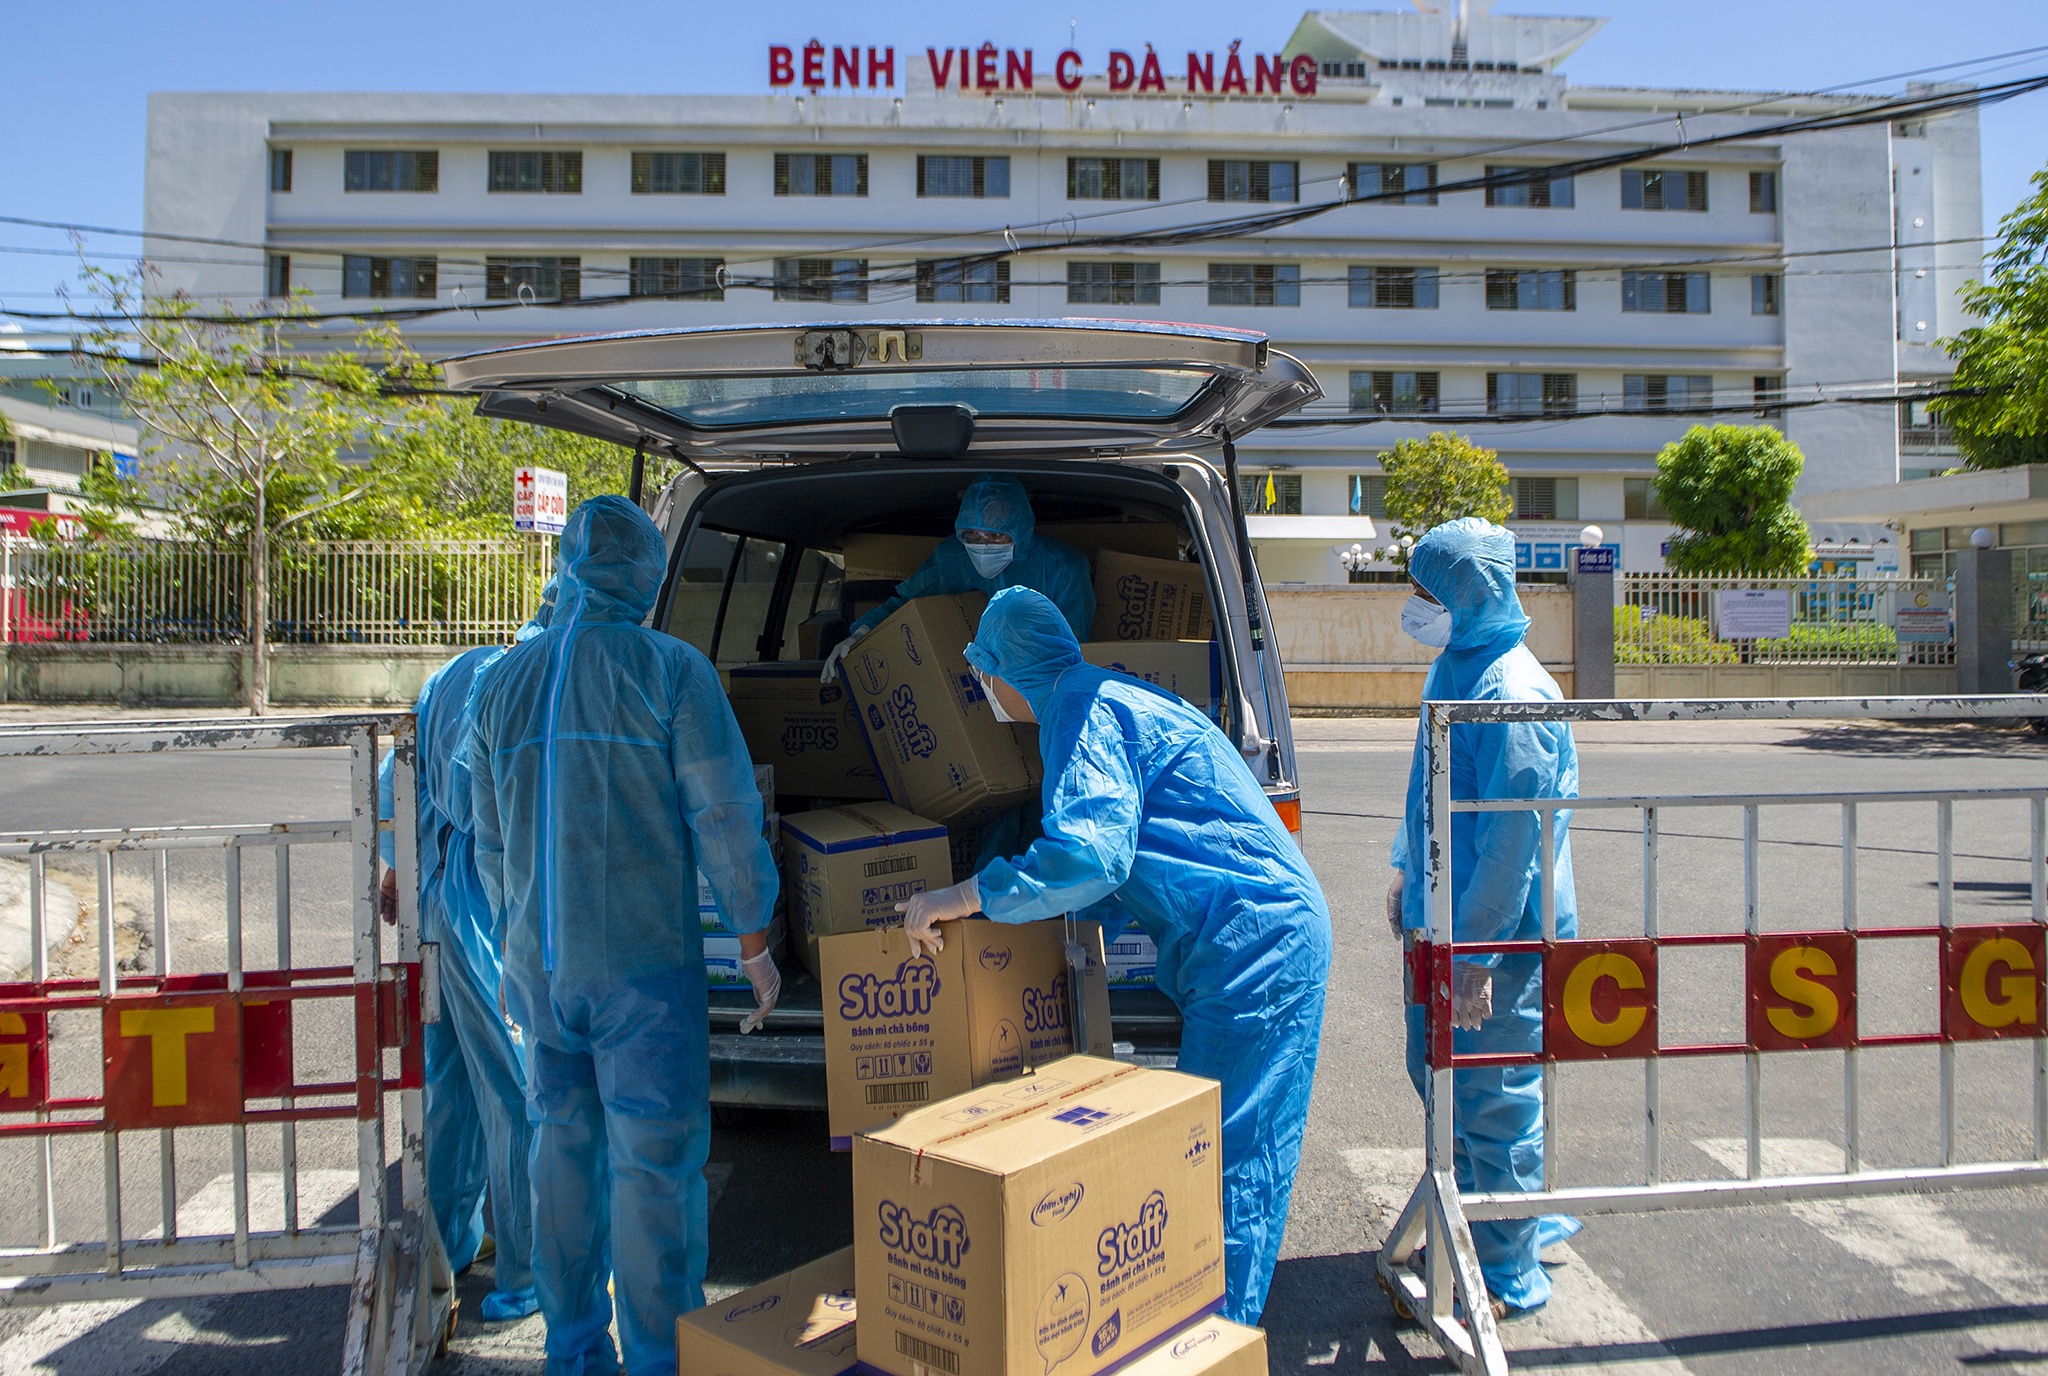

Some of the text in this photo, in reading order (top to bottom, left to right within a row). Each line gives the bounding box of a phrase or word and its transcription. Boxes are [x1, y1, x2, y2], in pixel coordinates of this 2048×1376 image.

[769, 38, 894, 96] BỆNH
[927, 40, 1033, 96] VIỆN
[1055, 50, 1084, 93] C
[1107, 42, 1167, 94] ĐÀ
[1580, 551, 1612, 564] CỔNG SỐ 1
[1117, 577, 1149, 640] Staff
[785, 725, 838, 751] Staff
[892, 684, 935, 756] Staff
[838, 964, 935, 1022] Staff
[1563, 938, 2038, 1047] C S G
[119, 1006, 215, 1108] T
[849, 1043, 863, 1052] Quy
[864, 1042, 883, 1051] cách:
[883, 1041, 892, 1049] 60
[892, 1039, 911, 1049] chiếc
[918, 1039, 928, 1047] 55
[929, 1039, 935, 1048] g
[851, 1022, 930, 1037] Bánh mì chà bông
[878, 1199, 965, 1270] Staff
[1097, 1197, 1166, 1278] Staff
[887, 1252, 967, 1290] Bánh mì chà bông
[1100, 1250, 1165, 1295] Bánh mì chà bông
[884, 1307, 897, 1320] Quy
[898, 1313, 916, 1327] cách:
[917, 1320, 926, 1330] 60
[926, 1324, 946, 1337] chiếc
[953, 1333, 962, 1344] 55
[964, 1338, 970, 1348] g
